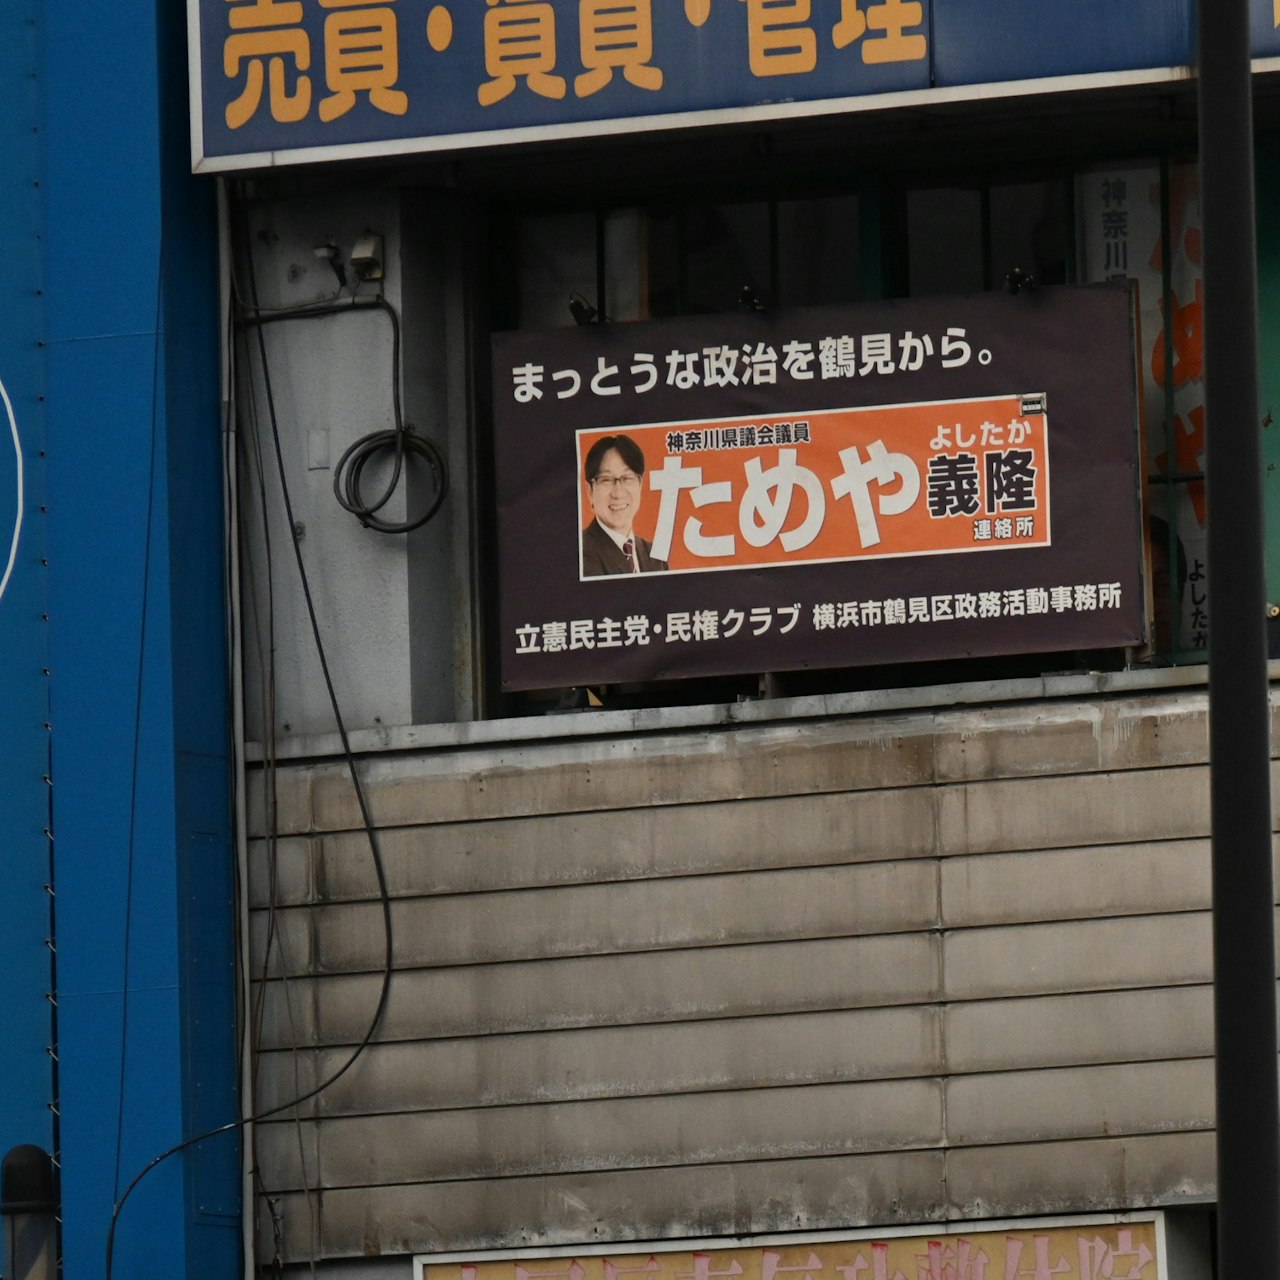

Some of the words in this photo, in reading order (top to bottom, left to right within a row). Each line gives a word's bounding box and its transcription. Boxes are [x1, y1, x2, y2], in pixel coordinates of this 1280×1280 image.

[1102, 177, 1128, 281] 神奈川
[512, 327, 993, 403] まっとうな政治を鶴見から。
[666, 422, 810, 454] 神奈川県議会議員
[929, 420, 1032, 450] よしたか
[650, 439, 920, 563] ためや
[926, 450, 1036, 518] 義隆
[973, 518, 1034, 542] 連絡所
[515, 603, 802, 655] 立憲民主党・民権クラブ
[813, 581, 1122, 629] 横浜市鶴見区政務活動事務所
